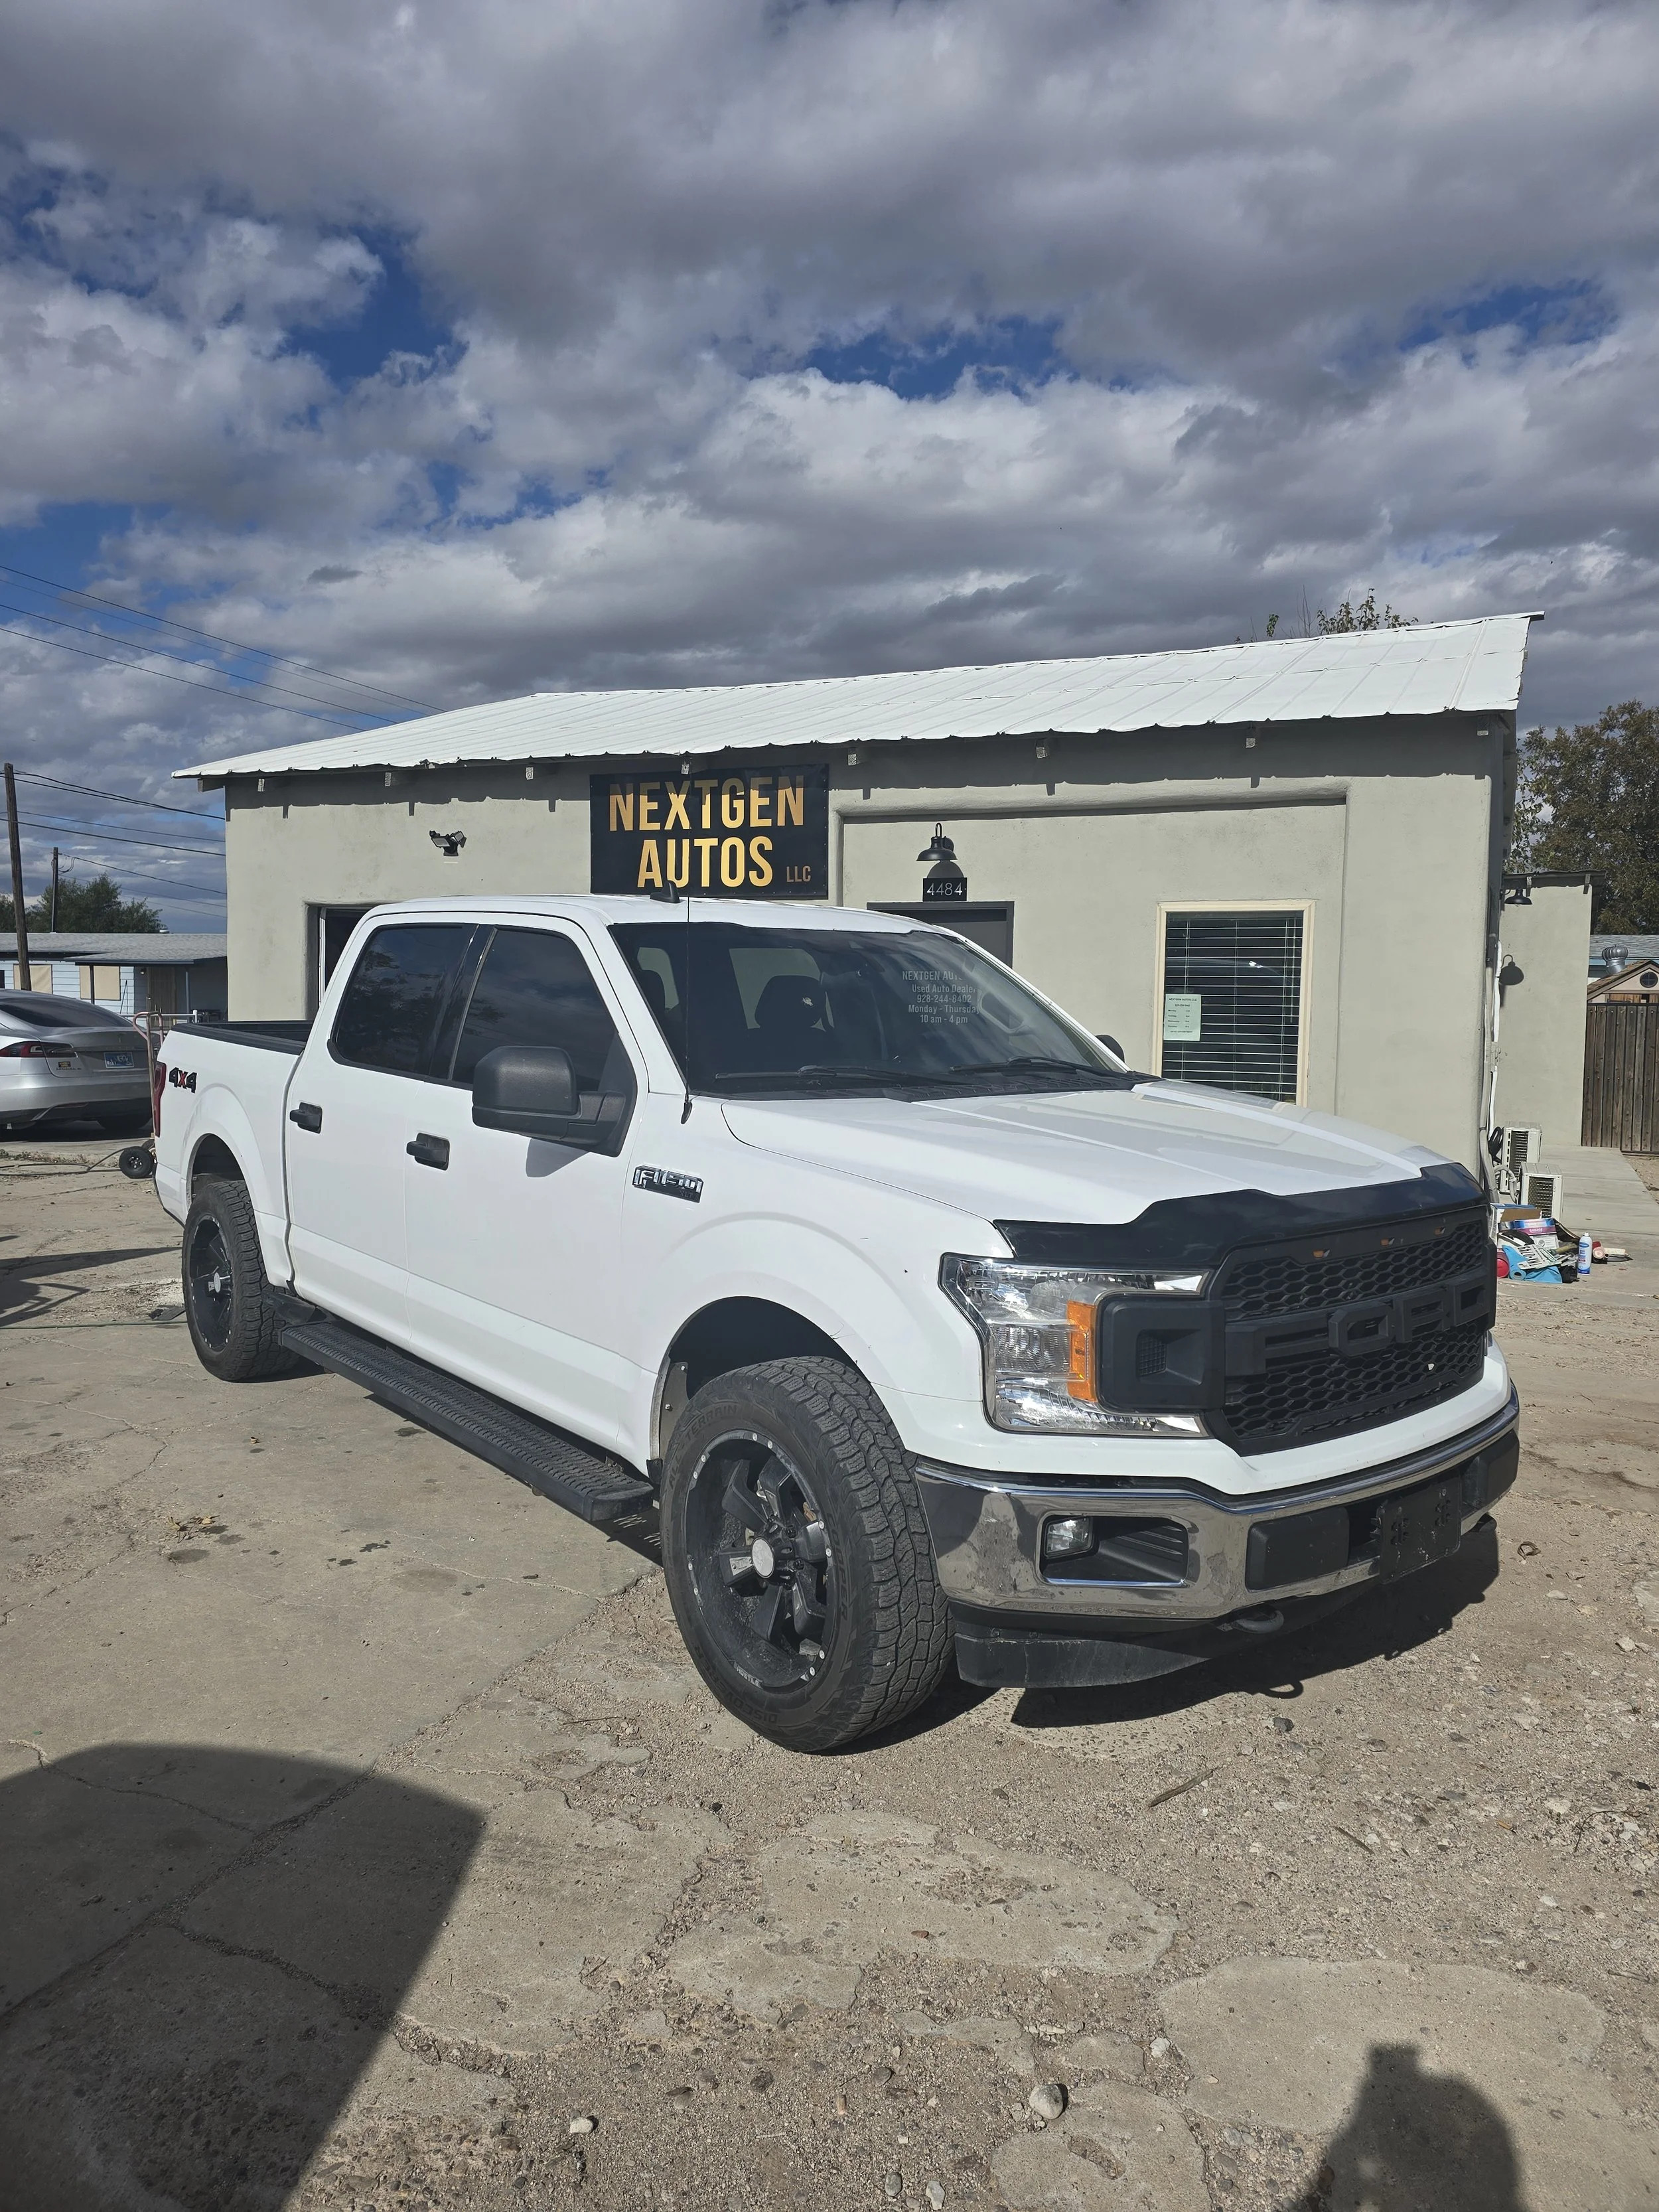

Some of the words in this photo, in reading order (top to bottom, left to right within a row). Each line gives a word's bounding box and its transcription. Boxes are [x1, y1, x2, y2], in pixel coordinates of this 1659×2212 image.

[609, 774, 804, 832] NEXTGEN
[637, 836, 773, 888] AUTOS
[786, 865, 811, 883] LLC
[926, 882, 963, 896] 4484
[902, 971, 940, 981] NEXTGEN
[912, 984, 930, 993] Used
[932, 984, 950, 993] Auto
[916, 994, 972, 1003] 928-244-8402
[908, 1004, 937, 1014] Monday
[945, 1004, 979, 1015] Thursday
[920, 1015, 928, 1023] 10
[949, 1015, 954, 1023] 4
[956, 1016, 968, 1025] pm
[827, 1512, 847, 1621] COOPER
